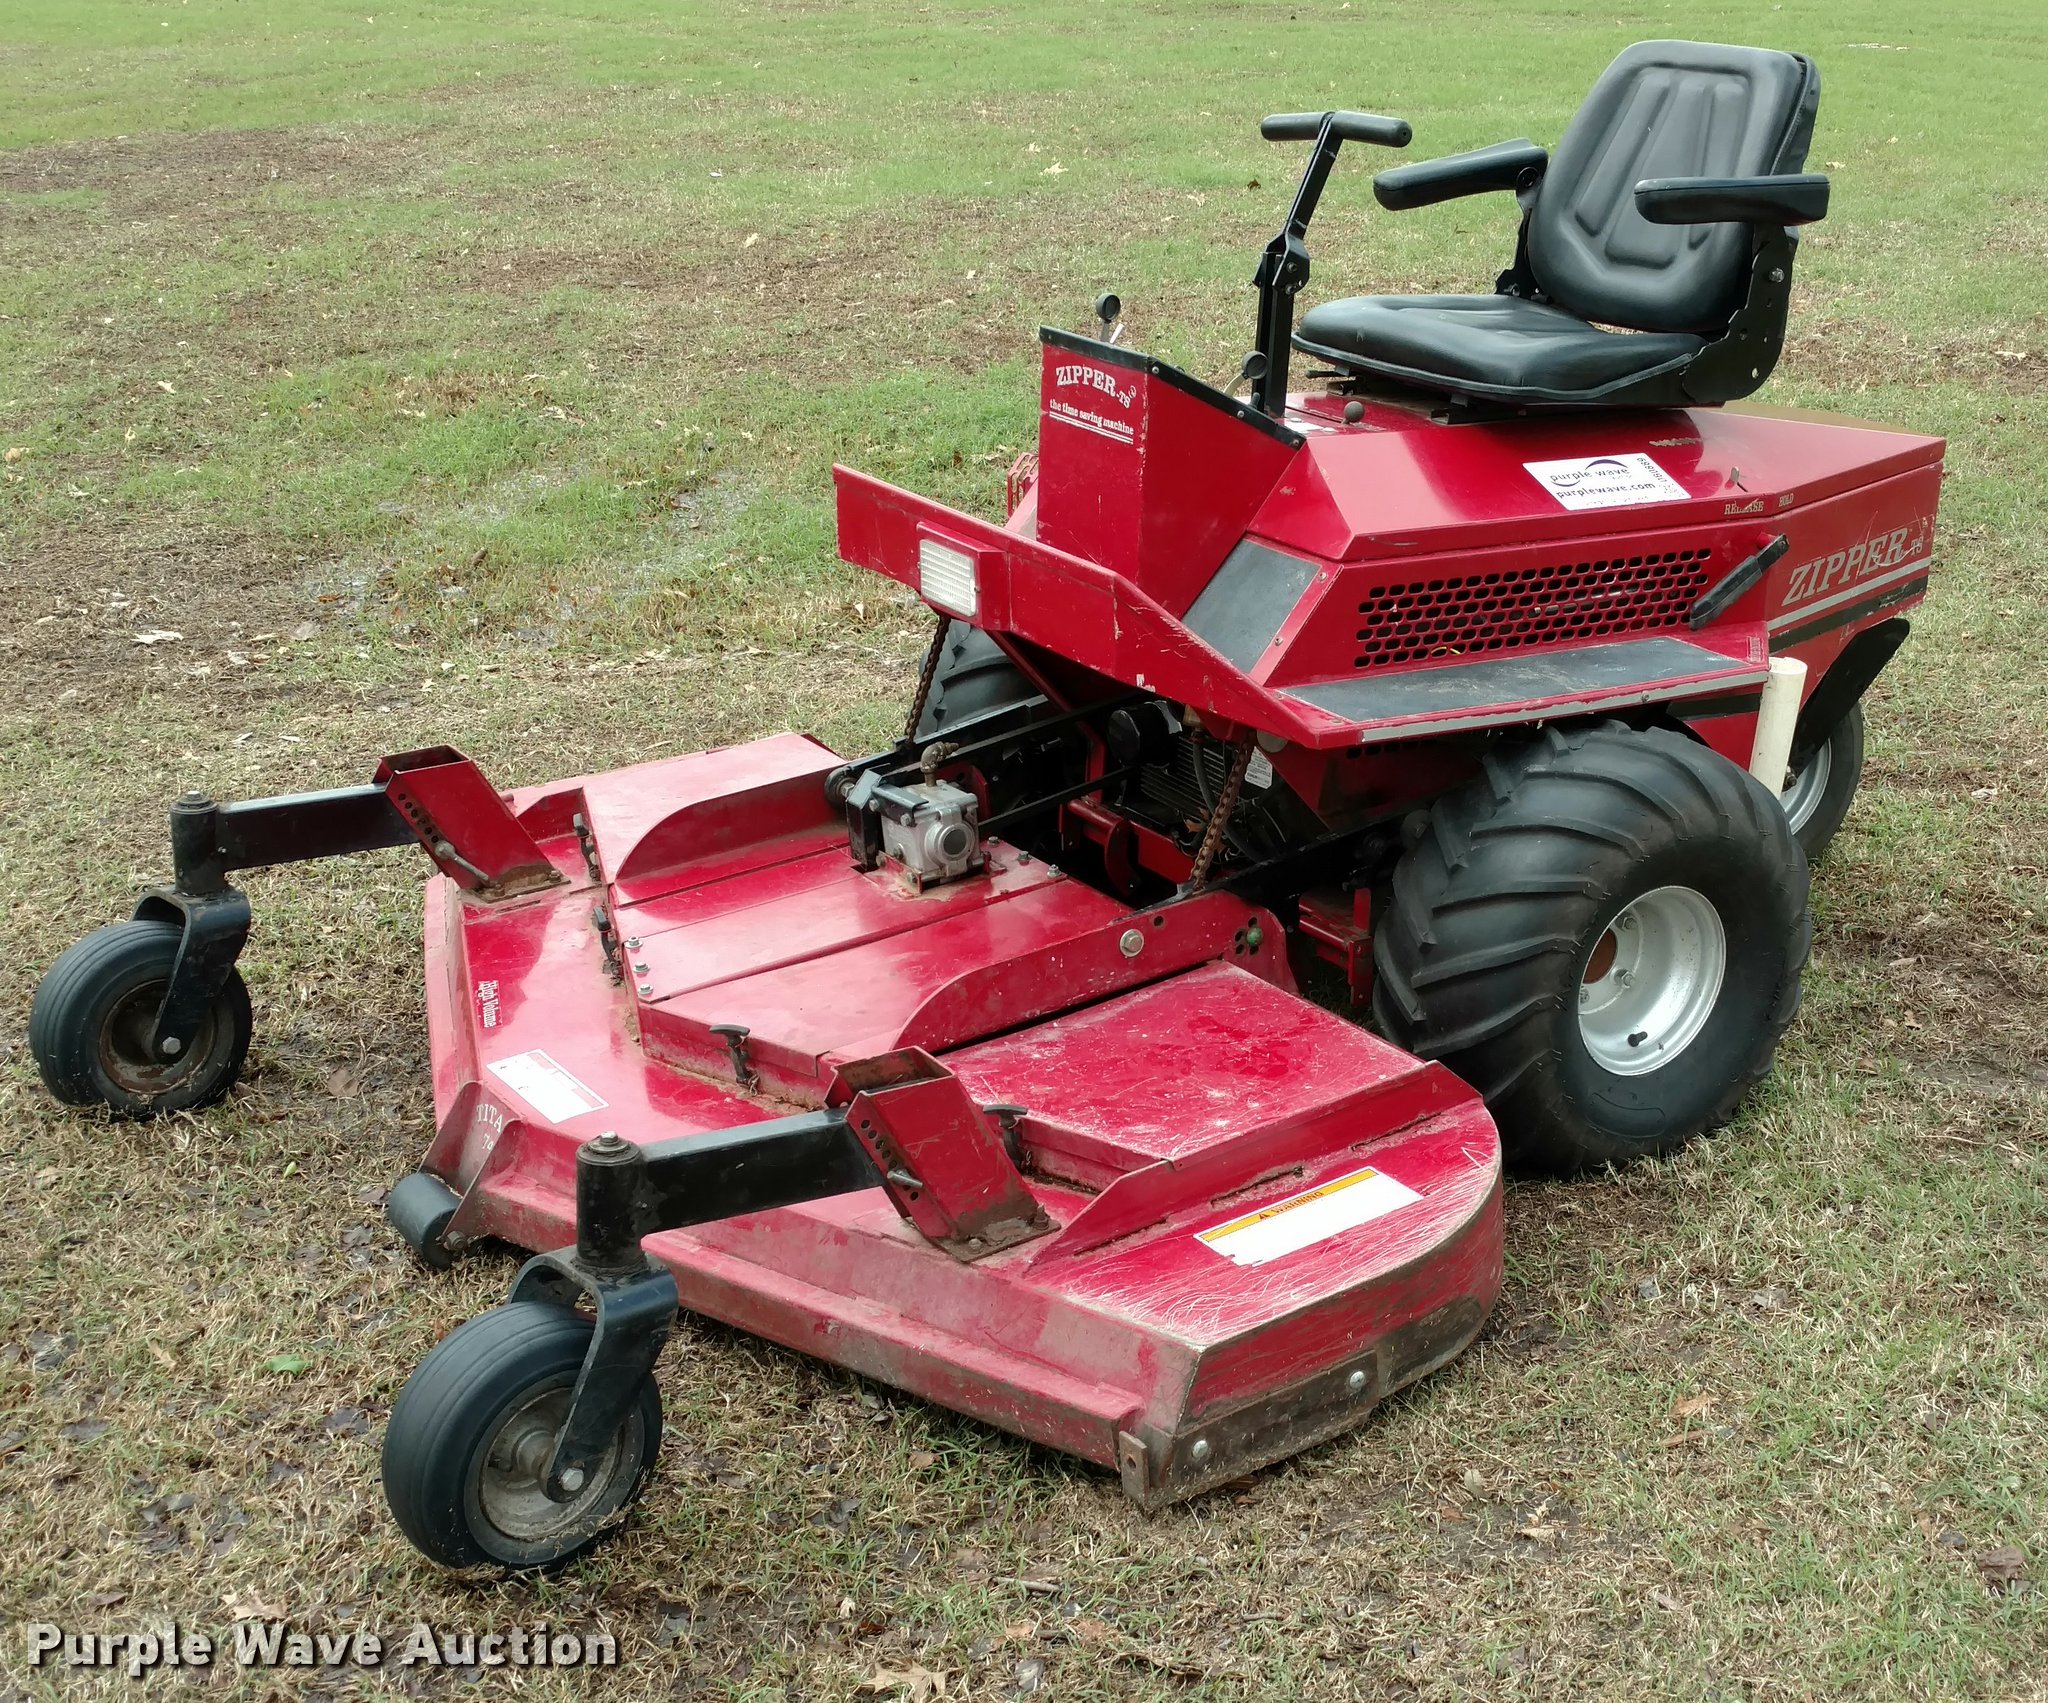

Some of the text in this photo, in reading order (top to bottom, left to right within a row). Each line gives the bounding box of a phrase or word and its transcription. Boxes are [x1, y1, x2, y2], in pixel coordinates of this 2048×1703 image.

[1049, 398, 1134, 435] the time saving machine
[1550, 471, 1592, 482] purple
[1595, 468, 1631, 477] wave
[1556, 482, 1656, 499] purplewave.com
[1724, 500, 1764, 515] RELASE
[1781, 526, 1909, 607] ZIPPER
[482, 999, 499, 1028] Volume
[476, 1103, 503, 1133] TITA
[1271, 1191, 1325, 1214] WARNING
